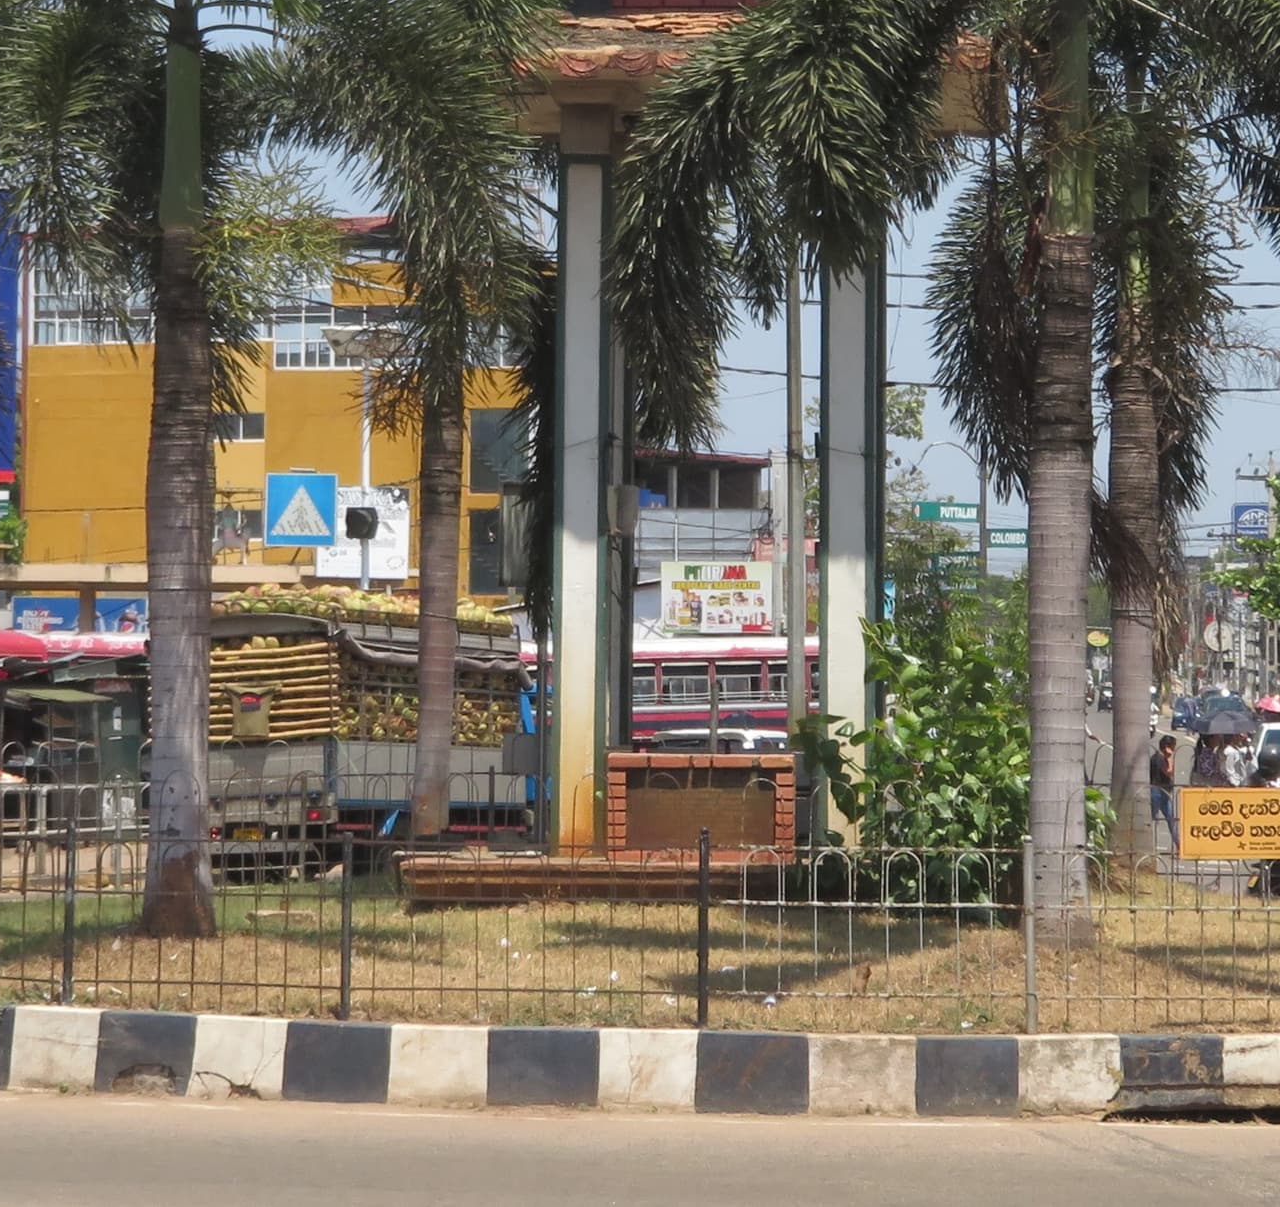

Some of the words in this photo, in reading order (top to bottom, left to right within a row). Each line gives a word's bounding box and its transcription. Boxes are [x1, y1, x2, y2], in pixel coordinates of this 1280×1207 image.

[939, 506, 978, 519] PUTTALAM
[990, 532, 1027, 545] COLOMBO
[1198, 800, 1234, 816] මෙහි
[1190, 820, 1245, 841] ඇලවීම
